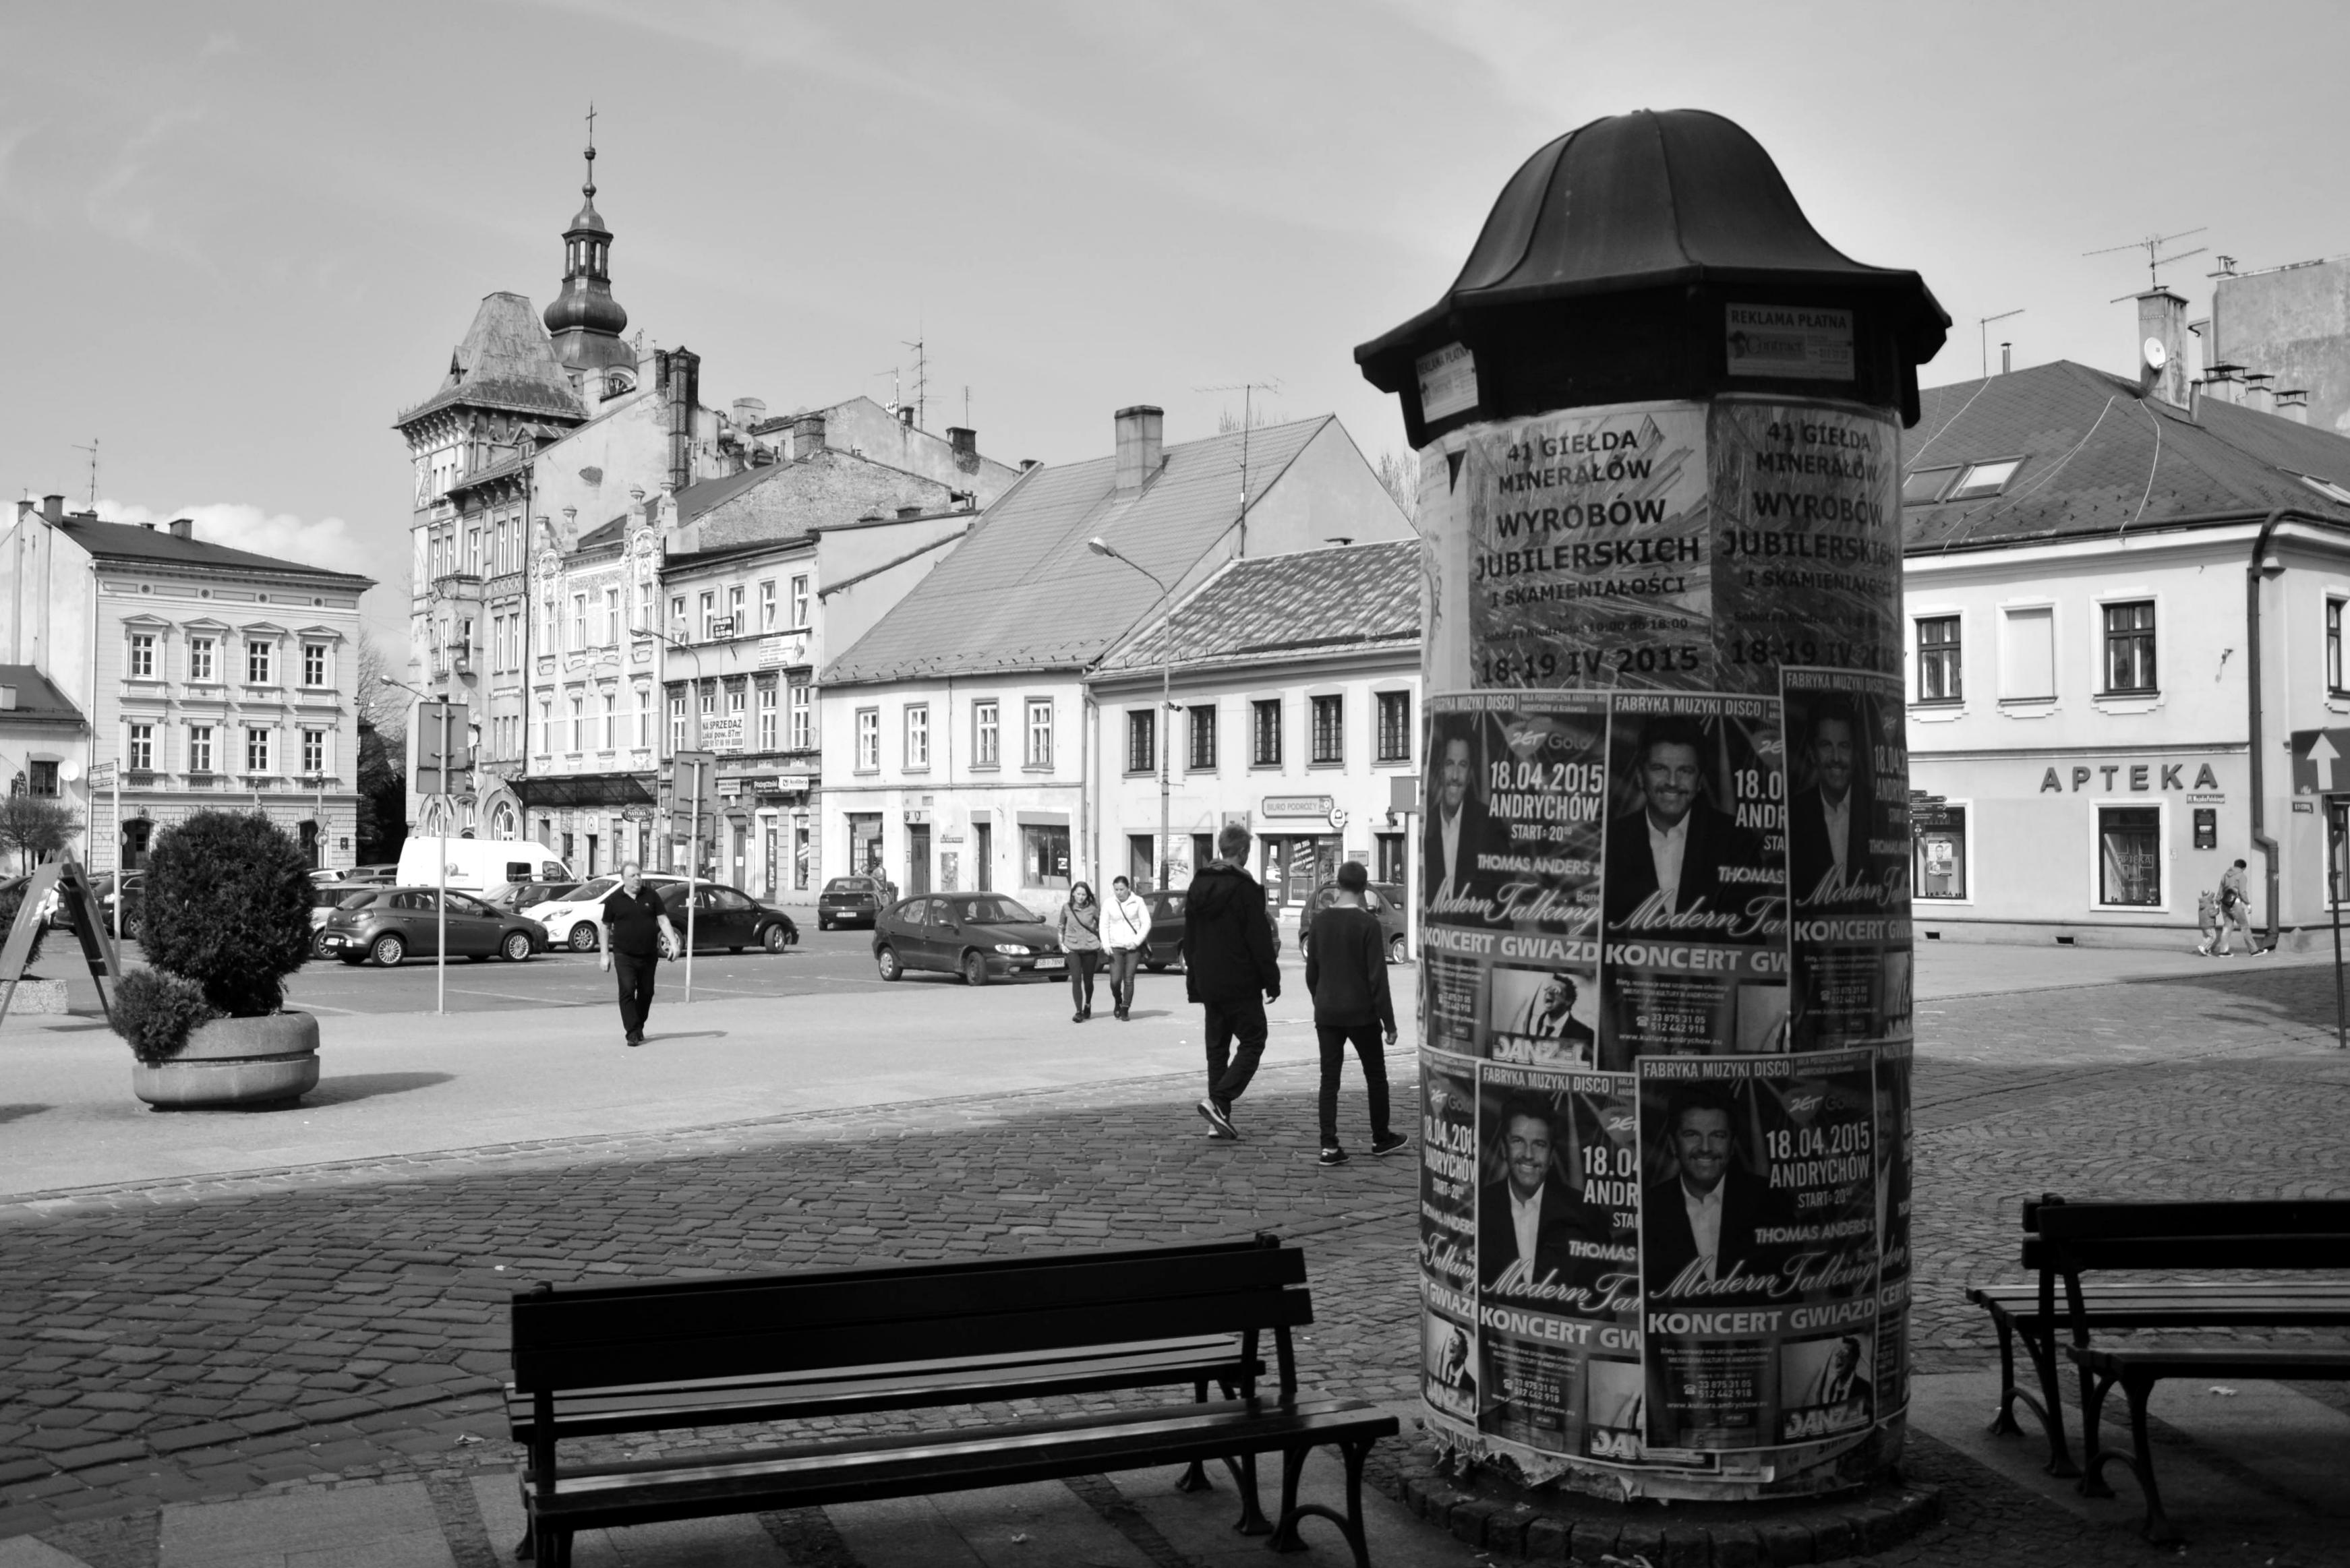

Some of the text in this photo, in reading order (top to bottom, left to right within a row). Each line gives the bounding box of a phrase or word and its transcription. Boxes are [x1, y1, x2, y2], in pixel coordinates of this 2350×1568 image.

[1731, 310, 1846, 329] REKLAMA PŁATNA
[1508, 430, 1638, 462] 41 GIEŁDA
[1767, 423, 1871, 452] 41 GIEŁDA
[1499, 454, 1652, 494] MINERAŁÓW
[1756, 452, 1877, 483] MINERAŁÓW
[1497, 492, 1666, 538] WYROBÓW
[1754, 492, 1883, 528] WYROBÓW
[1476, 537, 1699, 581] JUBILERSKICH
[1722, 531, 1895, 567] JUBILERSKICH
[1491, 573, 1686, 607] I SKAMIENIAŁOŚCI
[1746, 571, 1754, 588] I
[1651, 618, 1688, 630] 18:00
[1483, 646, 1699, 683] 18-19 IV 2015
[1732, 640, 1817, 665] 18-19
[1788, 672, 1831, 689] FABRYKA
[1833, 675, 1864, 691] MUZYKI
[1486, 695, 1515, 710] DISCO
[1616, 696, 1761, 717] FABRYKA MUZYKI DISCO
[702, 731, 713, 740] Lokal
[715, 731, 727, 741] pow.
[703, 717, 742, 730] NA SPRZEDAŻ
[1490, 760, 1604, 794] 18.04.2015
[1734, 768, 1783, 801] 18.0
[2039, 762, 2220, 793] APTEKA
[1488, 791, 1600, 822] ANDRYCHÓW
[1763, 835, 1784, 851] STA
[1477, 853, 1531, 872] THOMAS
[1532, 856, 1590, 876] ANDERS
[1718, 866, 1786, 884] THOMAS
[1794, 863, 1883, 907] Modern
[1426, 876, 1602, 937] Modern Talking
[1608, 888, 1742, 930] Modern
[1425, 926, 1599, 962] KONCERT GWIAZD
[1794, 919, 1886, 942] KONCERT
[1605, 943, 1789, 973] KONCERT GW
[1651, 1013, 1706, 1024] 33 875 31 05
[1651, 1022, 1706, 1033] 512 442 918
[1492, 1035, 1592, 1070] DANZEL
[1484, 1067, 1610, 1093] FABRYKA MUZYKI DISCO
[1643, 1060, 1790, 1079] FABRYKA MUZYKI DISCO
[1789, 1095, 1823, 1113] ZET
[1765, 1120, 1871, 1160] 18.04.2015
[1769, 1151, 1871, 1189] ANDRYCHÓW
[1755, 1225, 1818, 1244] THOMAS
[1821, 1219, 1867, 1239] ANDERS
[1568, 1240, 1636, 1261] THOMAS
[1481, 1258, 1592, 1302] Modern
[1649, 1250, 1877, 1299] Modern Talking
[1480, 1305, 1641, 1350] KONCERT GW
[1648, 1297, 1875, 1335] KONCERT GWIAZD
[1528, 1390, 1543, 1399] 442
[1544, 1393, 1560, 1403] 918
[1550, 1385, 1560, 1394] 05
[1698, 1389, 1753, 1398] 512 442 918
[1699, 1379, 1753, 1389] 33 875 31 05
